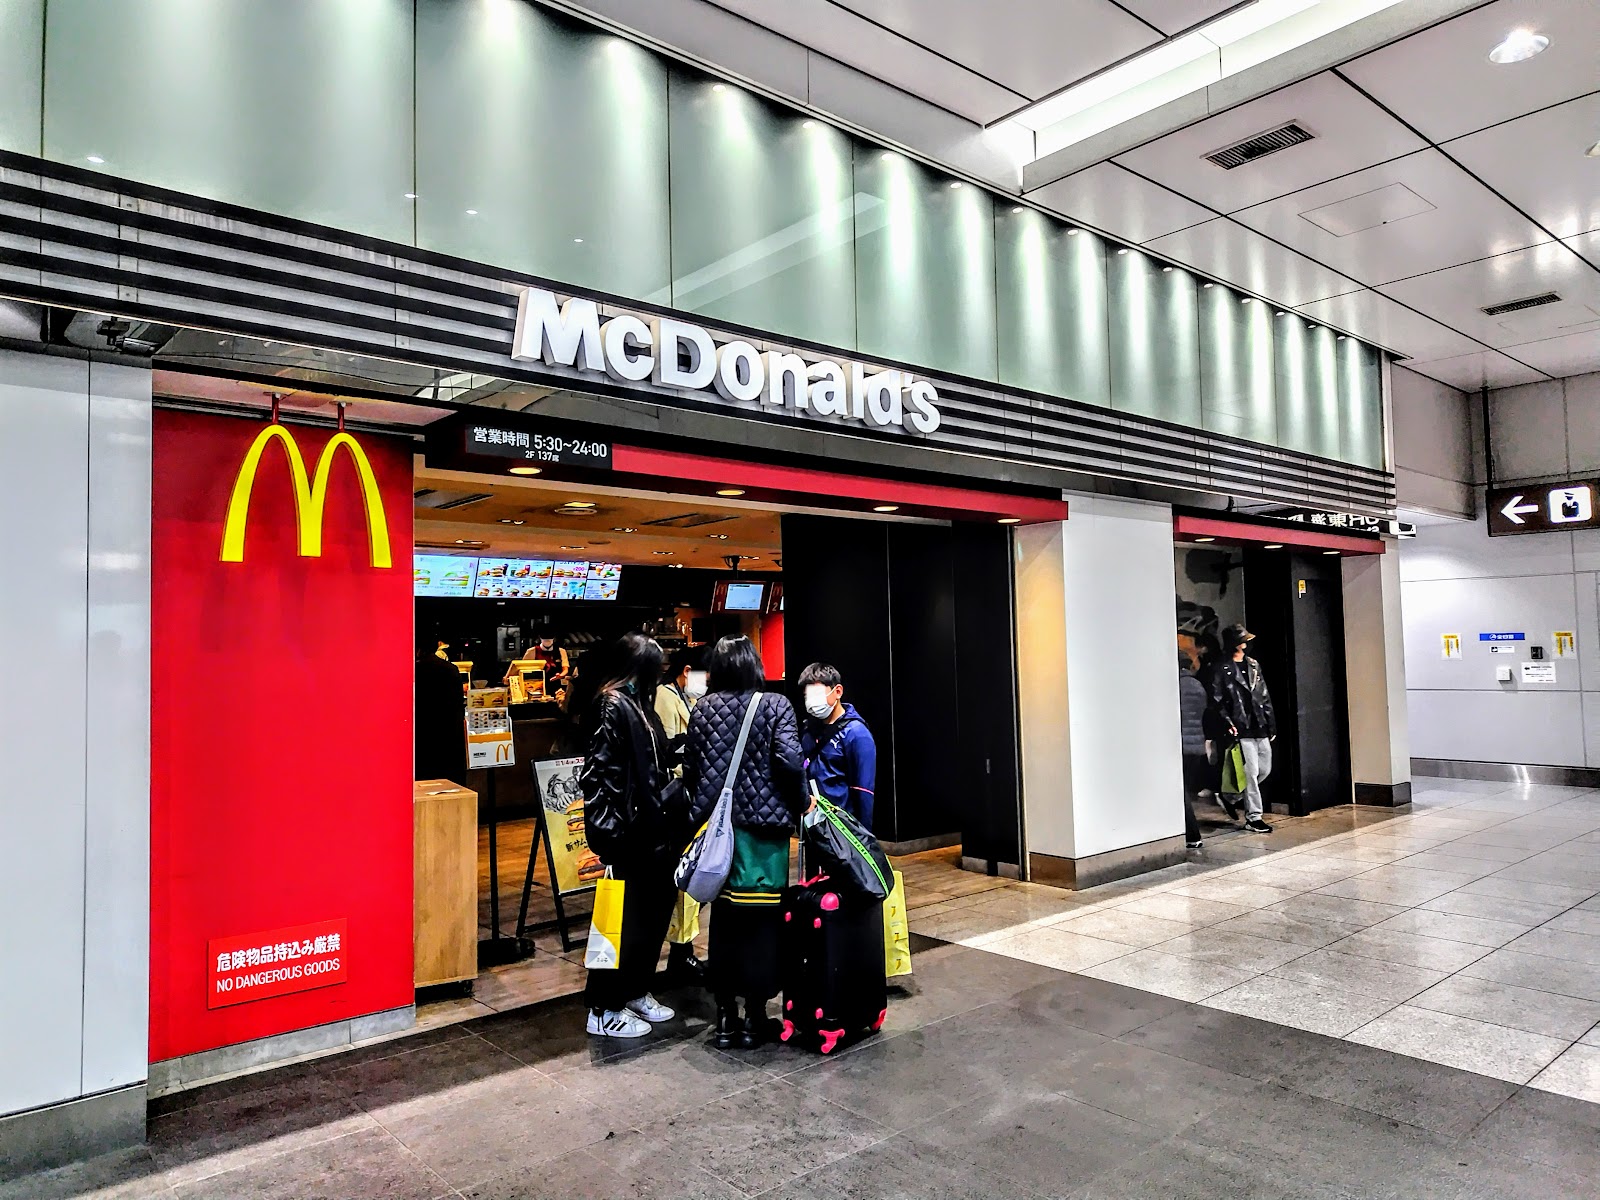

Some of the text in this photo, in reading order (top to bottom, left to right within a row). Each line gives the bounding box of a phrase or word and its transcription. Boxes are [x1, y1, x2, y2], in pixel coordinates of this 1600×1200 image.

[511, 287, 941, 435] McDonald's
[473, 427, 530, 448] 営業時間
[525, 450, 535, 459] 2F
[565, 839, 587, 853] 新サム
[216, 933, 341, 972] 危険物品持込み厳禁
[216, 958, 341, 993] NO DANGEROUS GOODS
